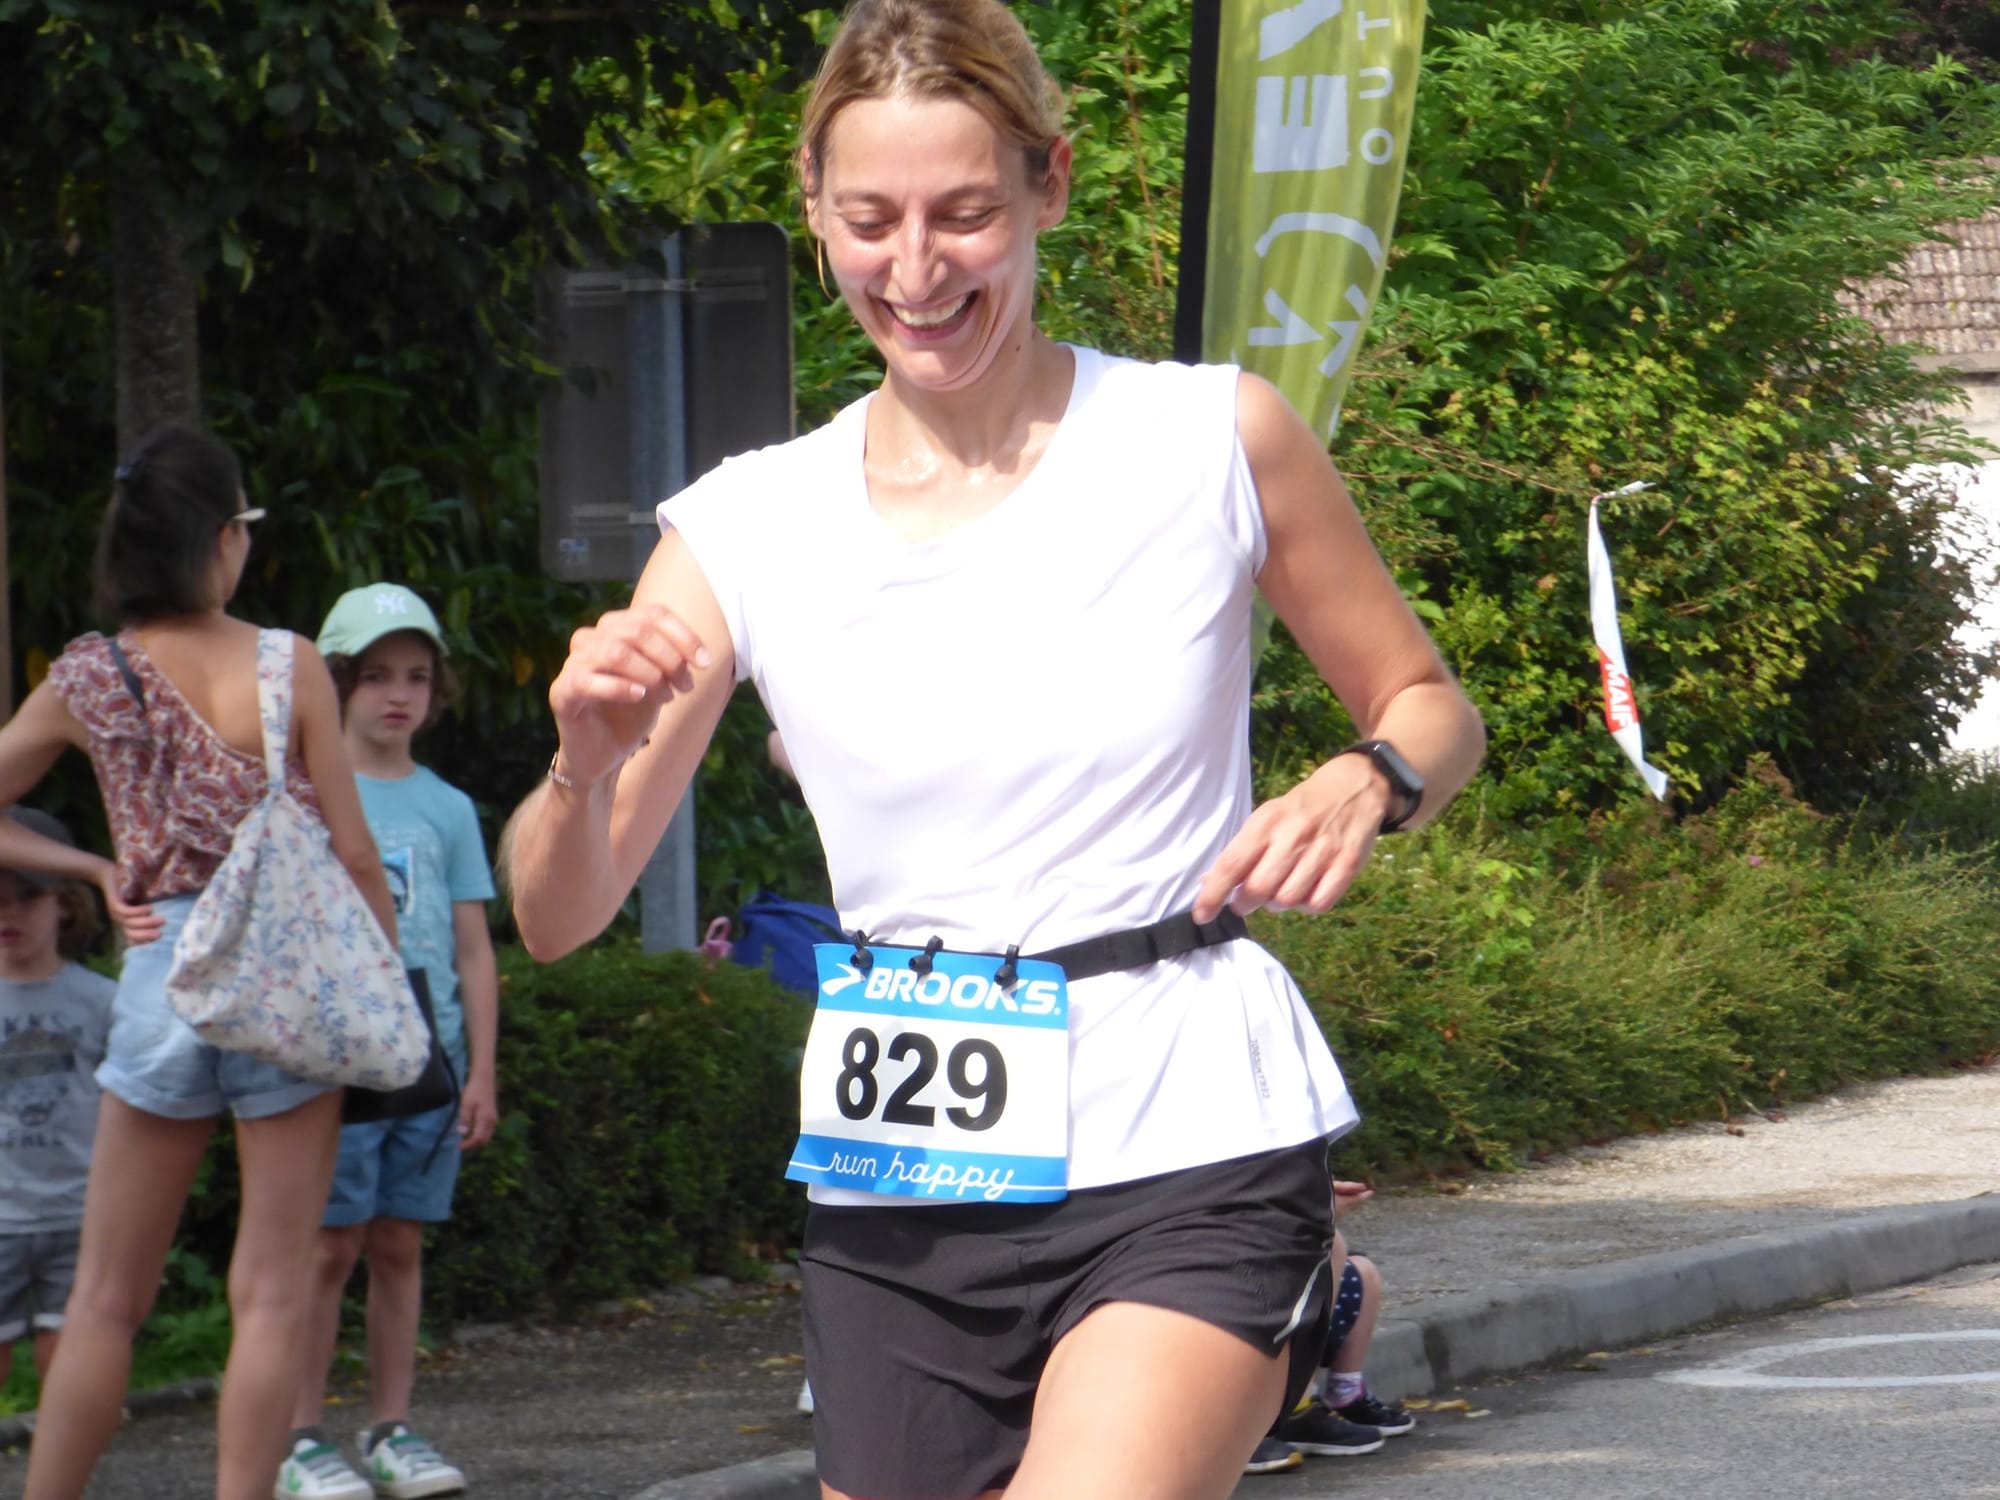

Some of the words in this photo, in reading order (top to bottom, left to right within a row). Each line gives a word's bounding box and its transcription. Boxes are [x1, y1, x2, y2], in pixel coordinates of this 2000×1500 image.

[1604, 662, 1635, 729] MAIF
[865, 967, 1060, 1015] BROOKS
[836, 1027, 1008, 1131] 829
[827, 1151, 877, 1178] run
[883, 1151, 1015, 1200] happy
